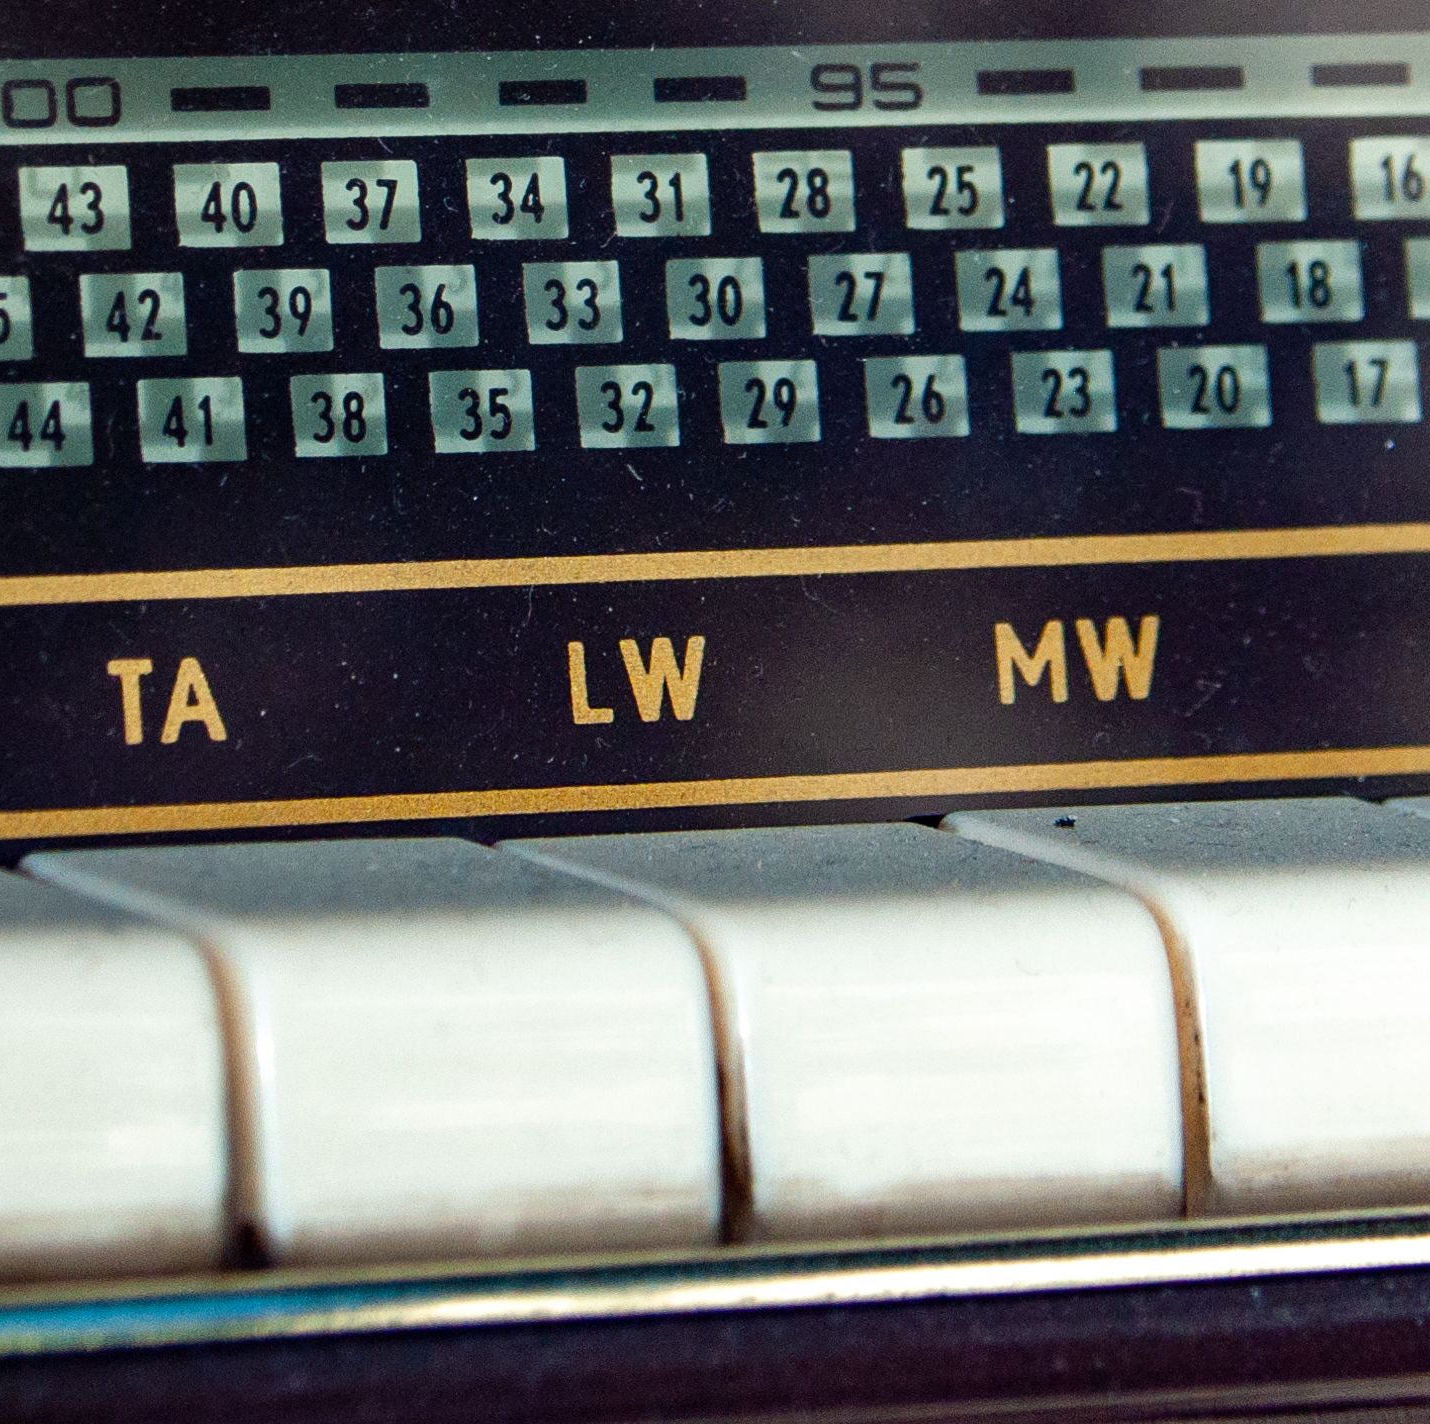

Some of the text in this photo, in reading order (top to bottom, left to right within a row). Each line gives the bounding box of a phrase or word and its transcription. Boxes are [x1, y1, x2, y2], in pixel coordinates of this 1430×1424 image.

[810, 63, 923, 111] 95
[46, 181, 105, 236] 43
[201, 181, 258, 233] 40
[346, 177, 399, 232] 37
[491, 172, 545, 226] 34
[637, 170, 684, 224] 31
[776, 166, 831, 221] 28
[927, 164, 980, 217] 25
[1072, 160, 1123, 213] 22
[1227, 157, 1273, 210] 19
[1379, 152, 1425, 206] 16
[106, 289, 163, 344] 42
[258, 285, 312, 339] 39
[400, 282, 455, 336] 36
[544, 277, 601, 331] 33
[688, 273, 743, 326] 30
[835, 271, 884, 322] 27
[984, 266, 1034, 317] 24
[1132, 263, 1175, 313] 21
[1286, 259, 1333, 310] 18
[8, 399, 66, 452] 44
[163, 394, 214, 448] 41
[311, 390, 367, 444] 38
[458, 387, 512, 442] 35
[600, 381, 655, 434] 32
[743, 377, 797, 430] 29
[892, 372, 945, 425] 26
[1041, 368, 1091, 419] 23
[1188, 362, 1241, 415] 20
[1341, 358, 1388, 408] 17
[108, 657, 229, 746] TA
[567, 635, 707, 726] LW
[994, 614, 1160, 706] MW
